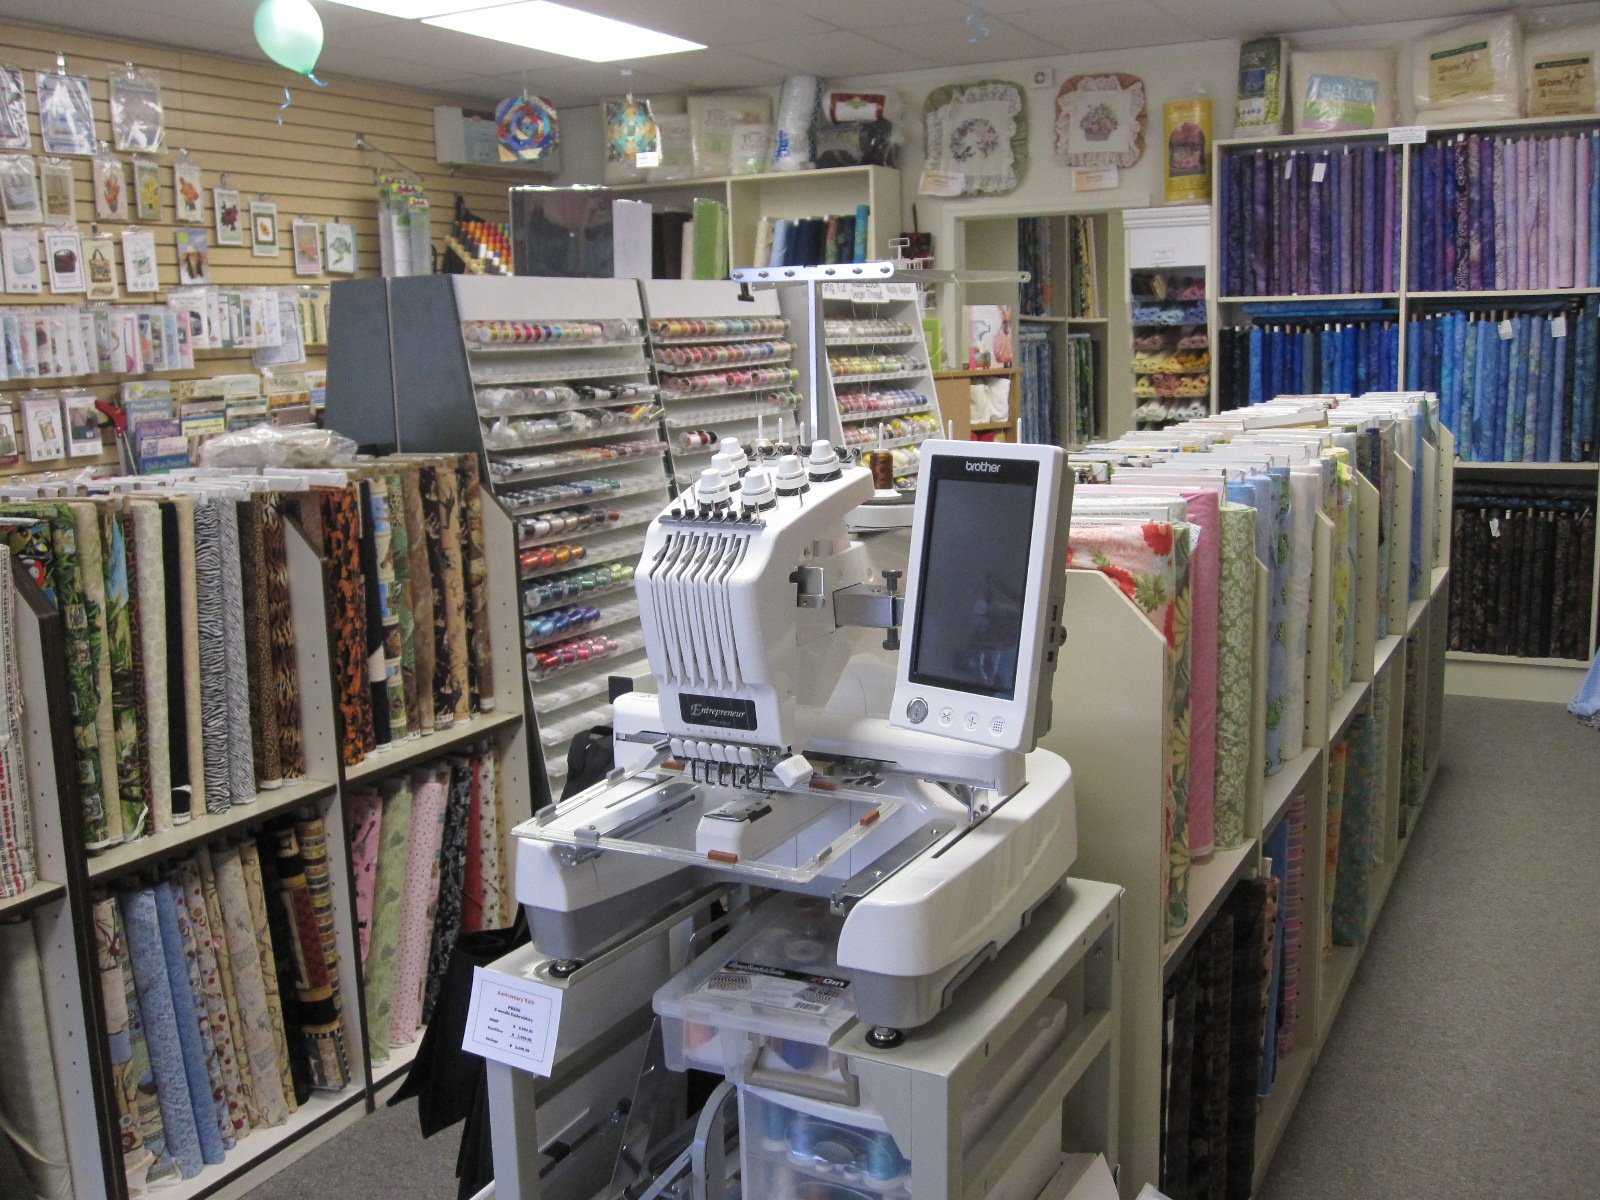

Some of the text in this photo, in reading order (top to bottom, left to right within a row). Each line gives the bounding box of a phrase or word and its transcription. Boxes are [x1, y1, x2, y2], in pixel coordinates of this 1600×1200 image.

[965, 460, 1002, 473] brother
[690, 703, 746, 718] Entrepreneur
[3, 804, 12, 839] RODEO
[497, 990, 535, 1006] Anniversary Sale
[510, 1012, 534, 1023] Embroidery
